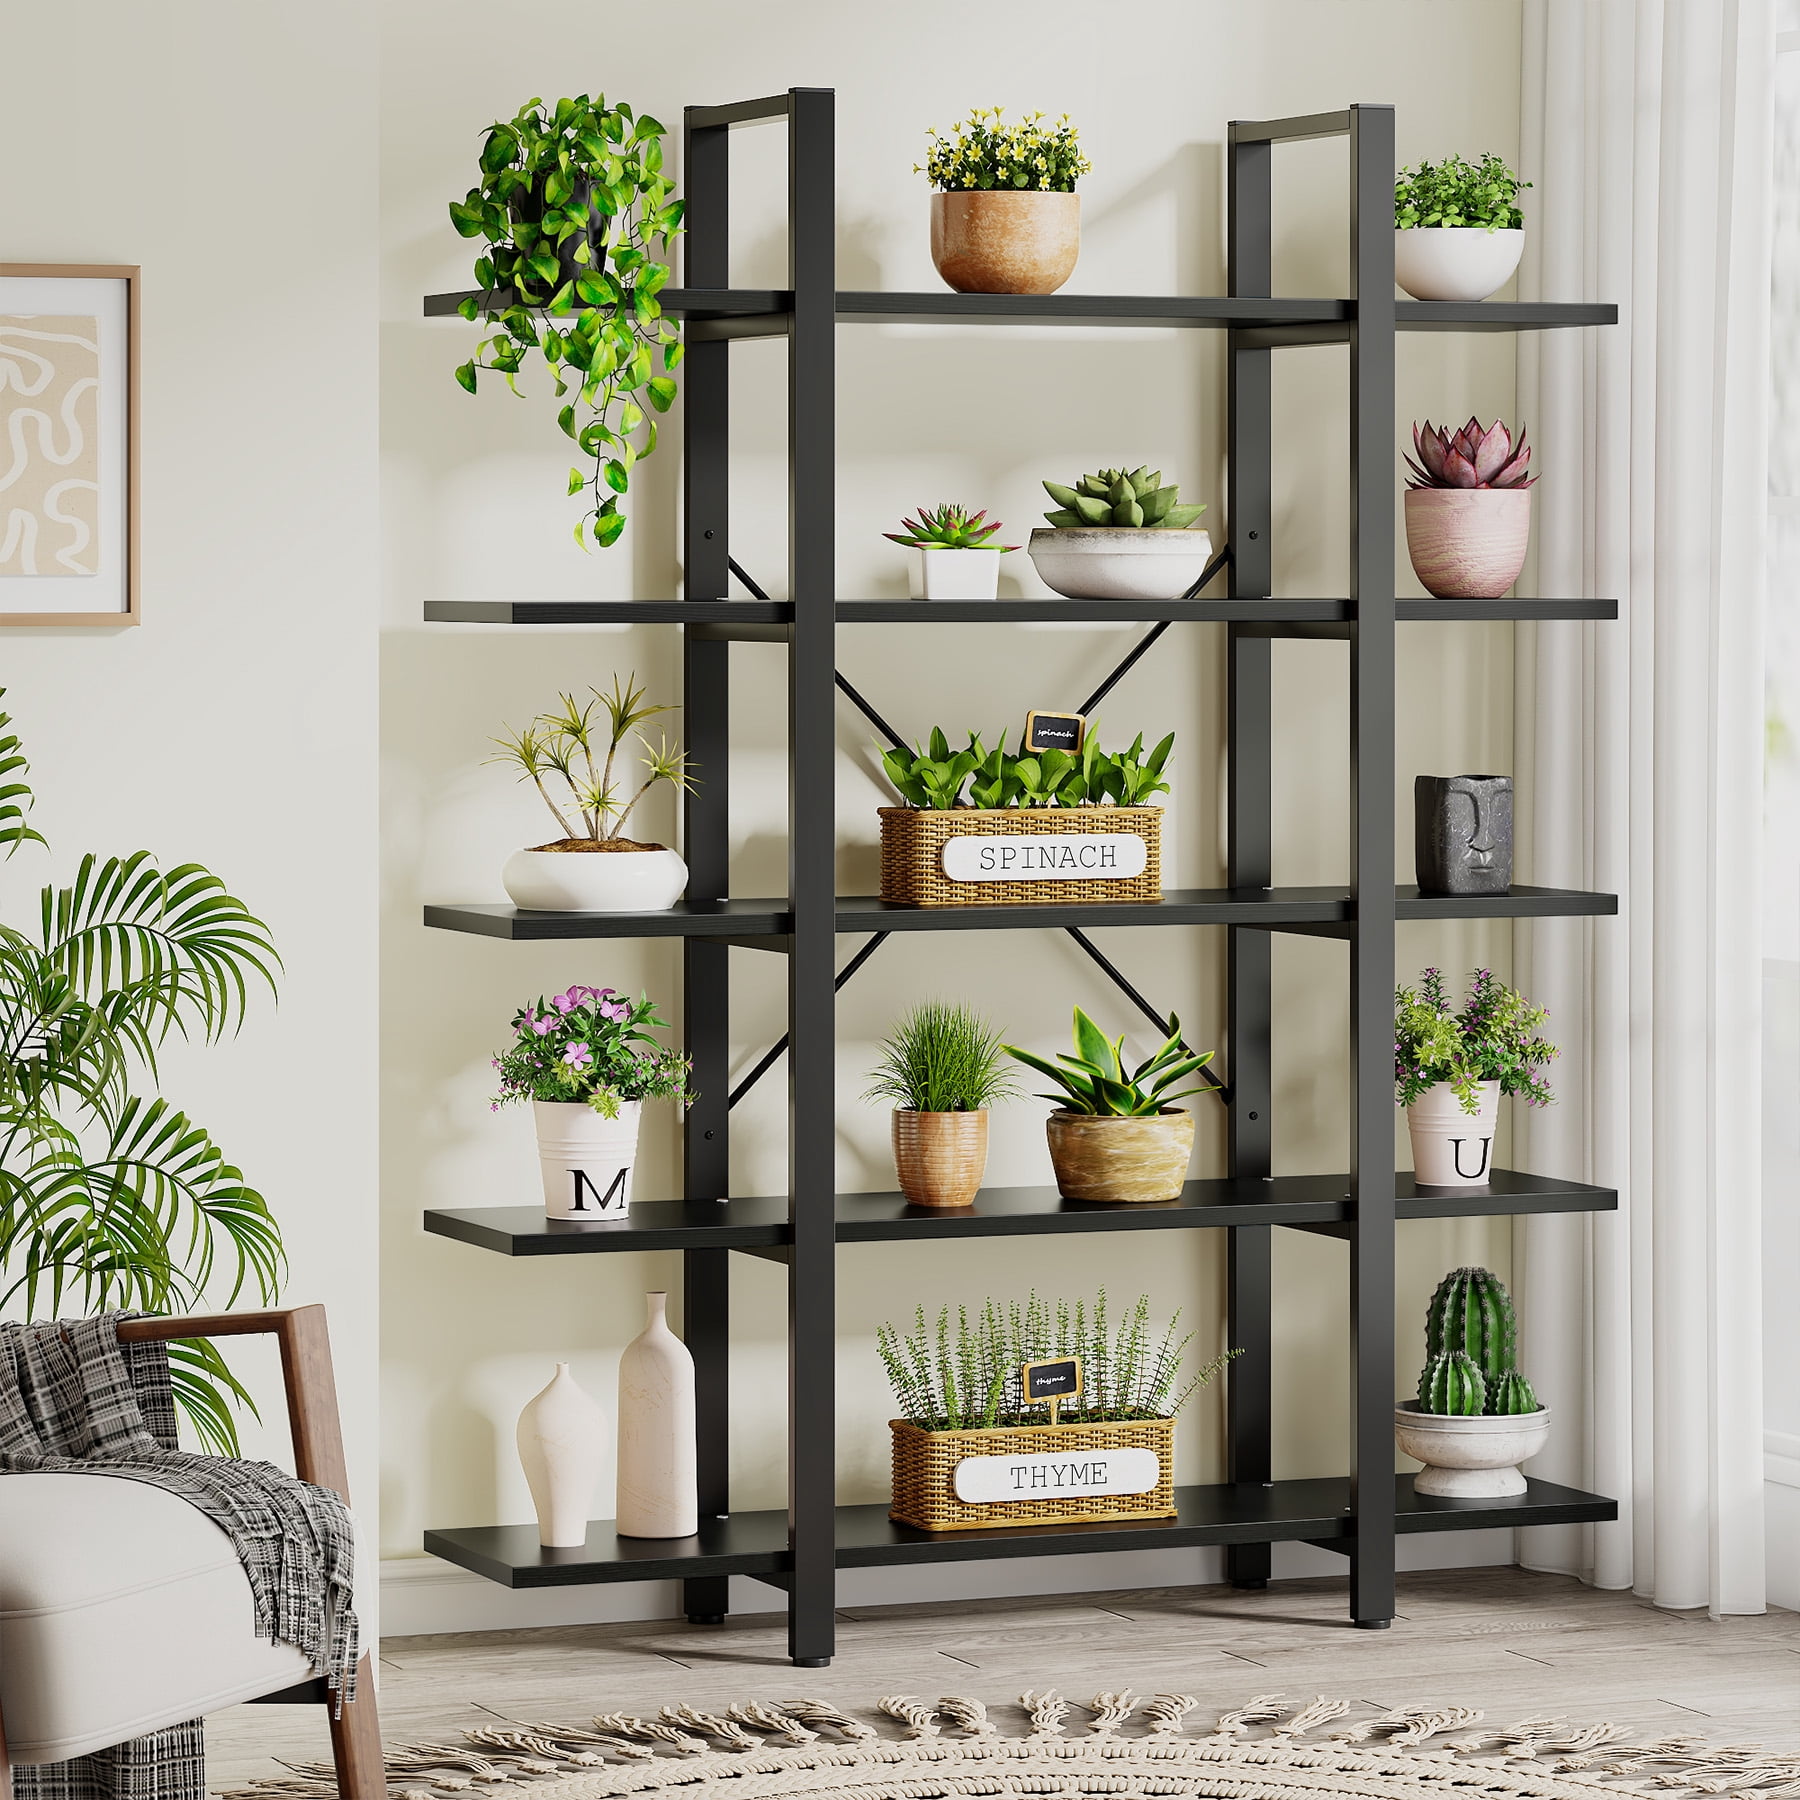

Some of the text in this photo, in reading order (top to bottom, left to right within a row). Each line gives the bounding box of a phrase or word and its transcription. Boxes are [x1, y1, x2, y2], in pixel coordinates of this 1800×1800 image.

[1037, 728, 1075, 739] spinach
[980, 845, 1117, 870] SPINACH
[1447, 1137, 1492, 1179] U
[566, 1166, 631, 1212] M
[1035, 1375, 1067, 1386] thyme
[1010, 1461, 1108, 1490] THYME
